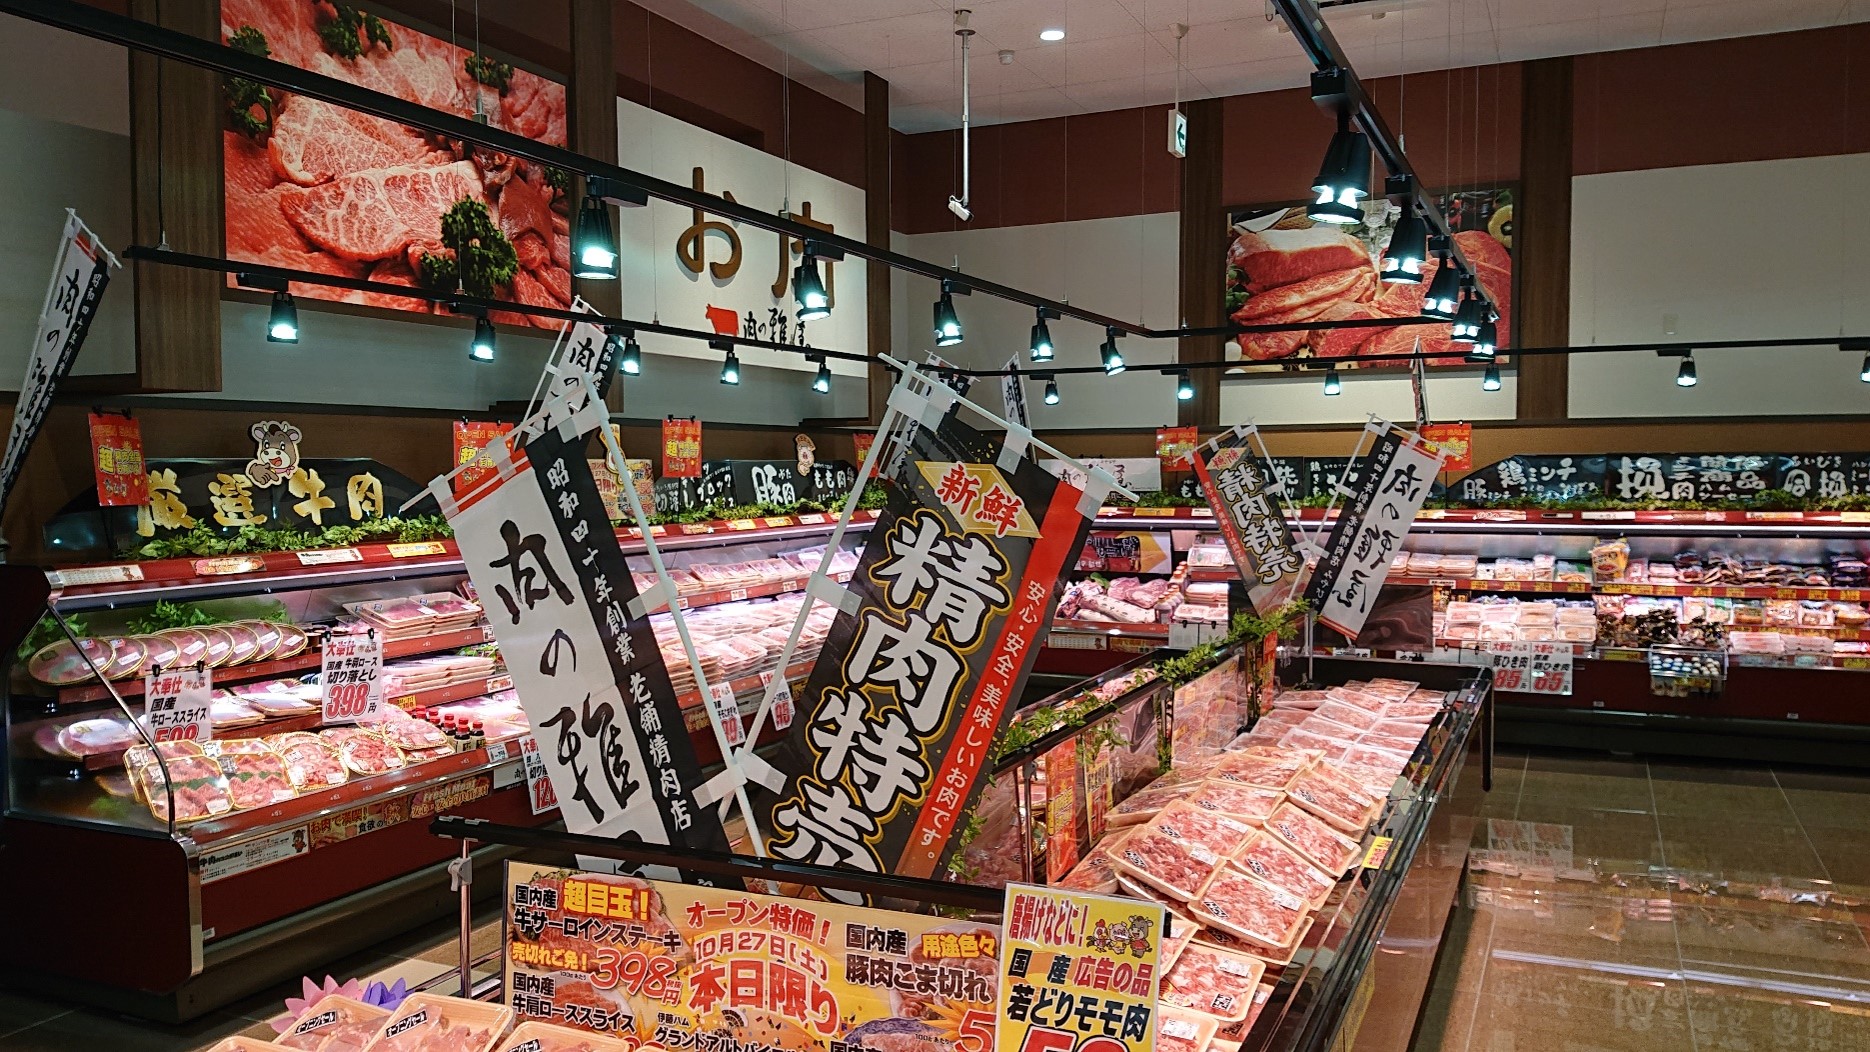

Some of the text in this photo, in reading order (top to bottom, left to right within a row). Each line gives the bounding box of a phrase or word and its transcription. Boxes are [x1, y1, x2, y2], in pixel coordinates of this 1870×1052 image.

[934, 461, 1022, 537] 新鮮
[547, 458, 694, 832] 昭和四十年創業 老舗精肉店
[150, 676, 182, 696] 大奉仕
[327, 669, 377, 684] 切り落とし
[150, 697, 177, 712] 国産
[150, 707, 207, 727] 牛ローススライス
[326, 682, 370, 719] 398
[926, 579, 1047, 861] 安心・安全、美味しいお肉です。
[514, 885, 557, 909] 国内産
[564, 880, 649, 920] 超目玉！
[514, 908, 681, 953] 牛サーロインステーキ
[686, 898, 832, 945] オープン特価！
[845, 923, 906, 956] 国内産
[512, 942, 588, 971] 売切れご免！
[921, 934, 996, 959] 用途色々
[512, 972, 555, 997] 国内産
[590, 948, 674, 999] 398
[663, 988, 681, 1006] 円
[845, 955, 992, 1002] 豚肉こま切れ
[1073, 956, 1154, 997] 広告の品
[512, 997, 636, 1033] 牛肩ローススライス
[690, 960, 840, 1036] 本日限り
[1007, 983, 1151, 1042] 若どりモモ肉
[386, 1010, 427, 1036] オープニングセール
[657, 1012, 690, 1027] 伊藤ハム
